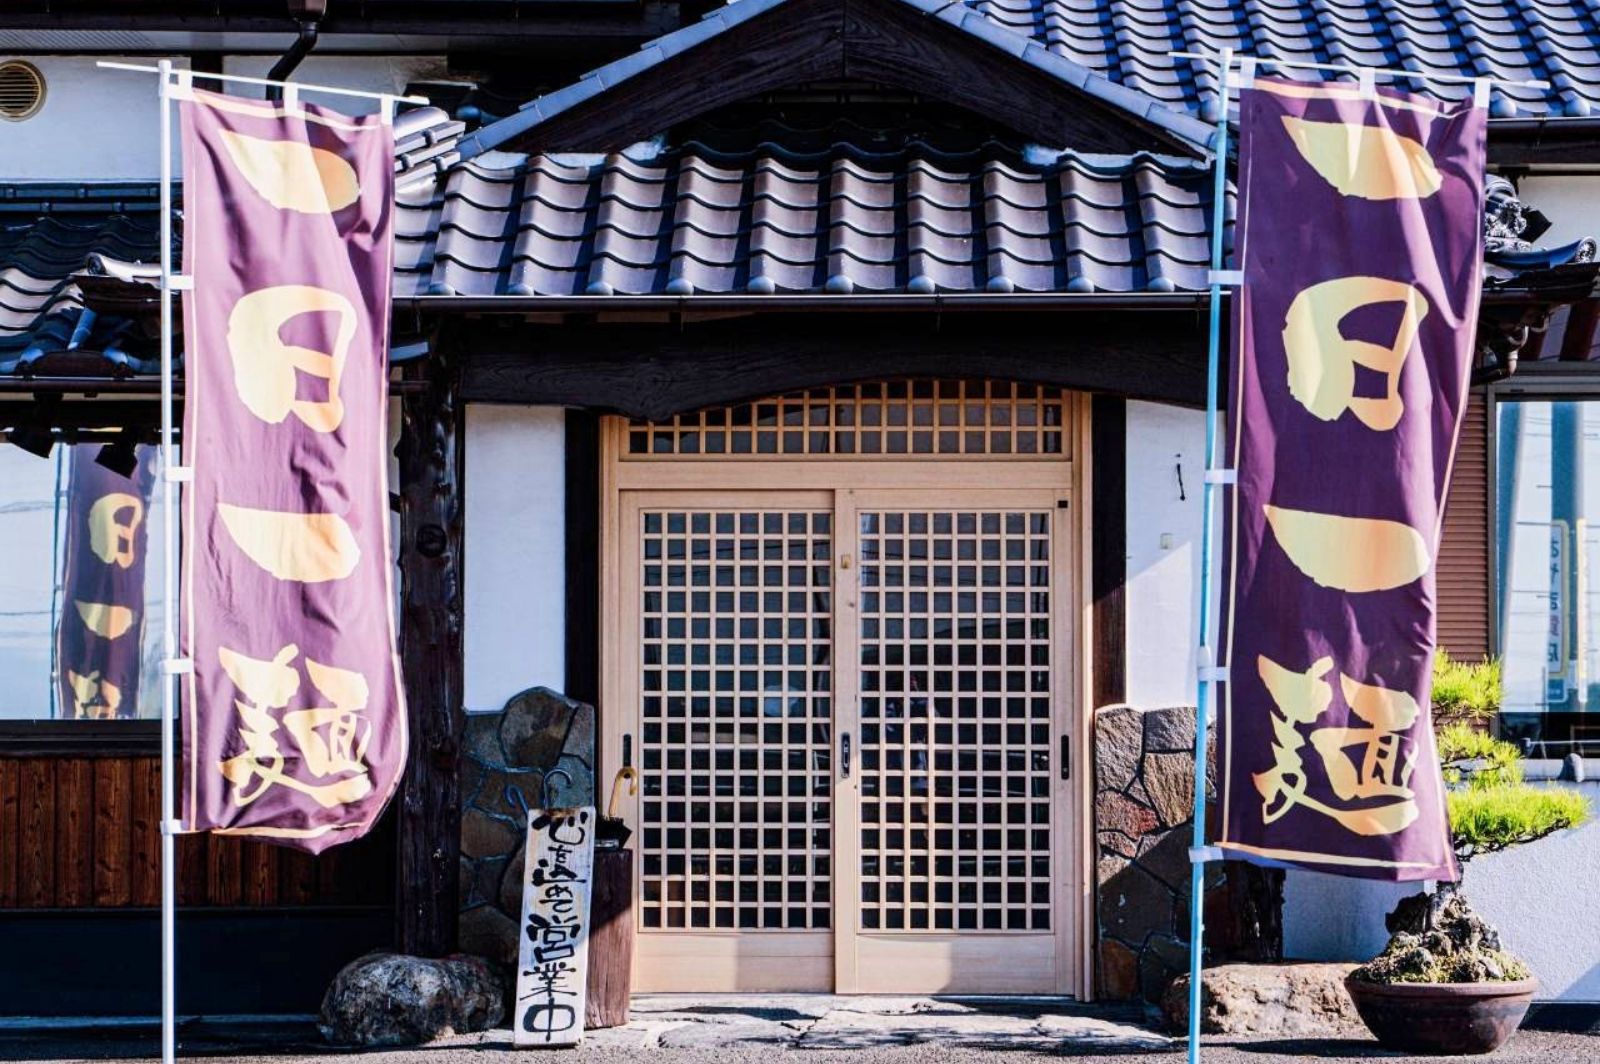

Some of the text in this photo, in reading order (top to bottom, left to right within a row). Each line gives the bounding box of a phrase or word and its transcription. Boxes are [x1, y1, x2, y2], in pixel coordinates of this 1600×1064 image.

[519, 811, 588, 1042] 心を込めて営業中
